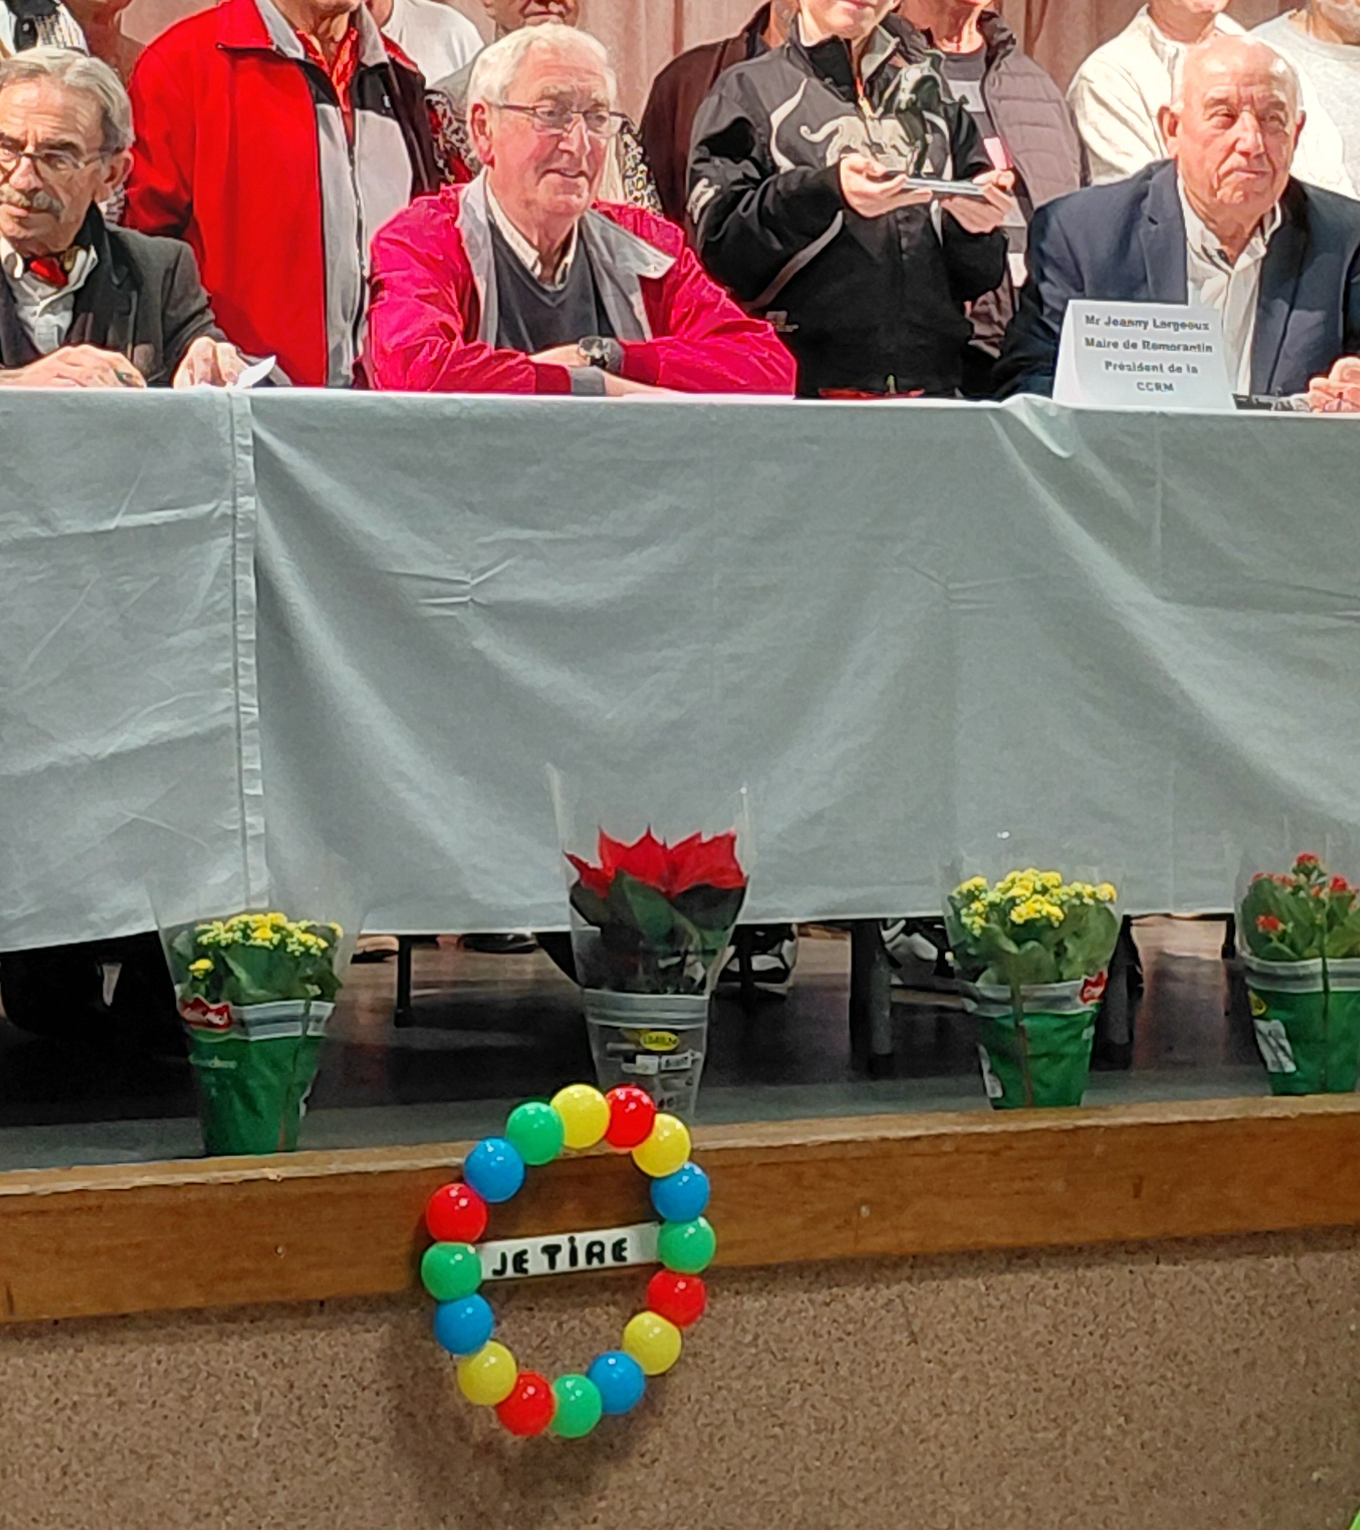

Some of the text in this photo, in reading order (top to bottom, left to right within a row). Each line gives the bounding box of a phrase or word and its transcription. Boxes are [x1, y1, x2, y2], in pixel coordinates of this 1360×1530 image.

[1085, 315, 1100, 325] Mr
[1085, 337, 1213, 353] Maire de Romorantin
[1105, 361, 1199, 374] Président de la
[492, 1249, 529, 1277] JE
